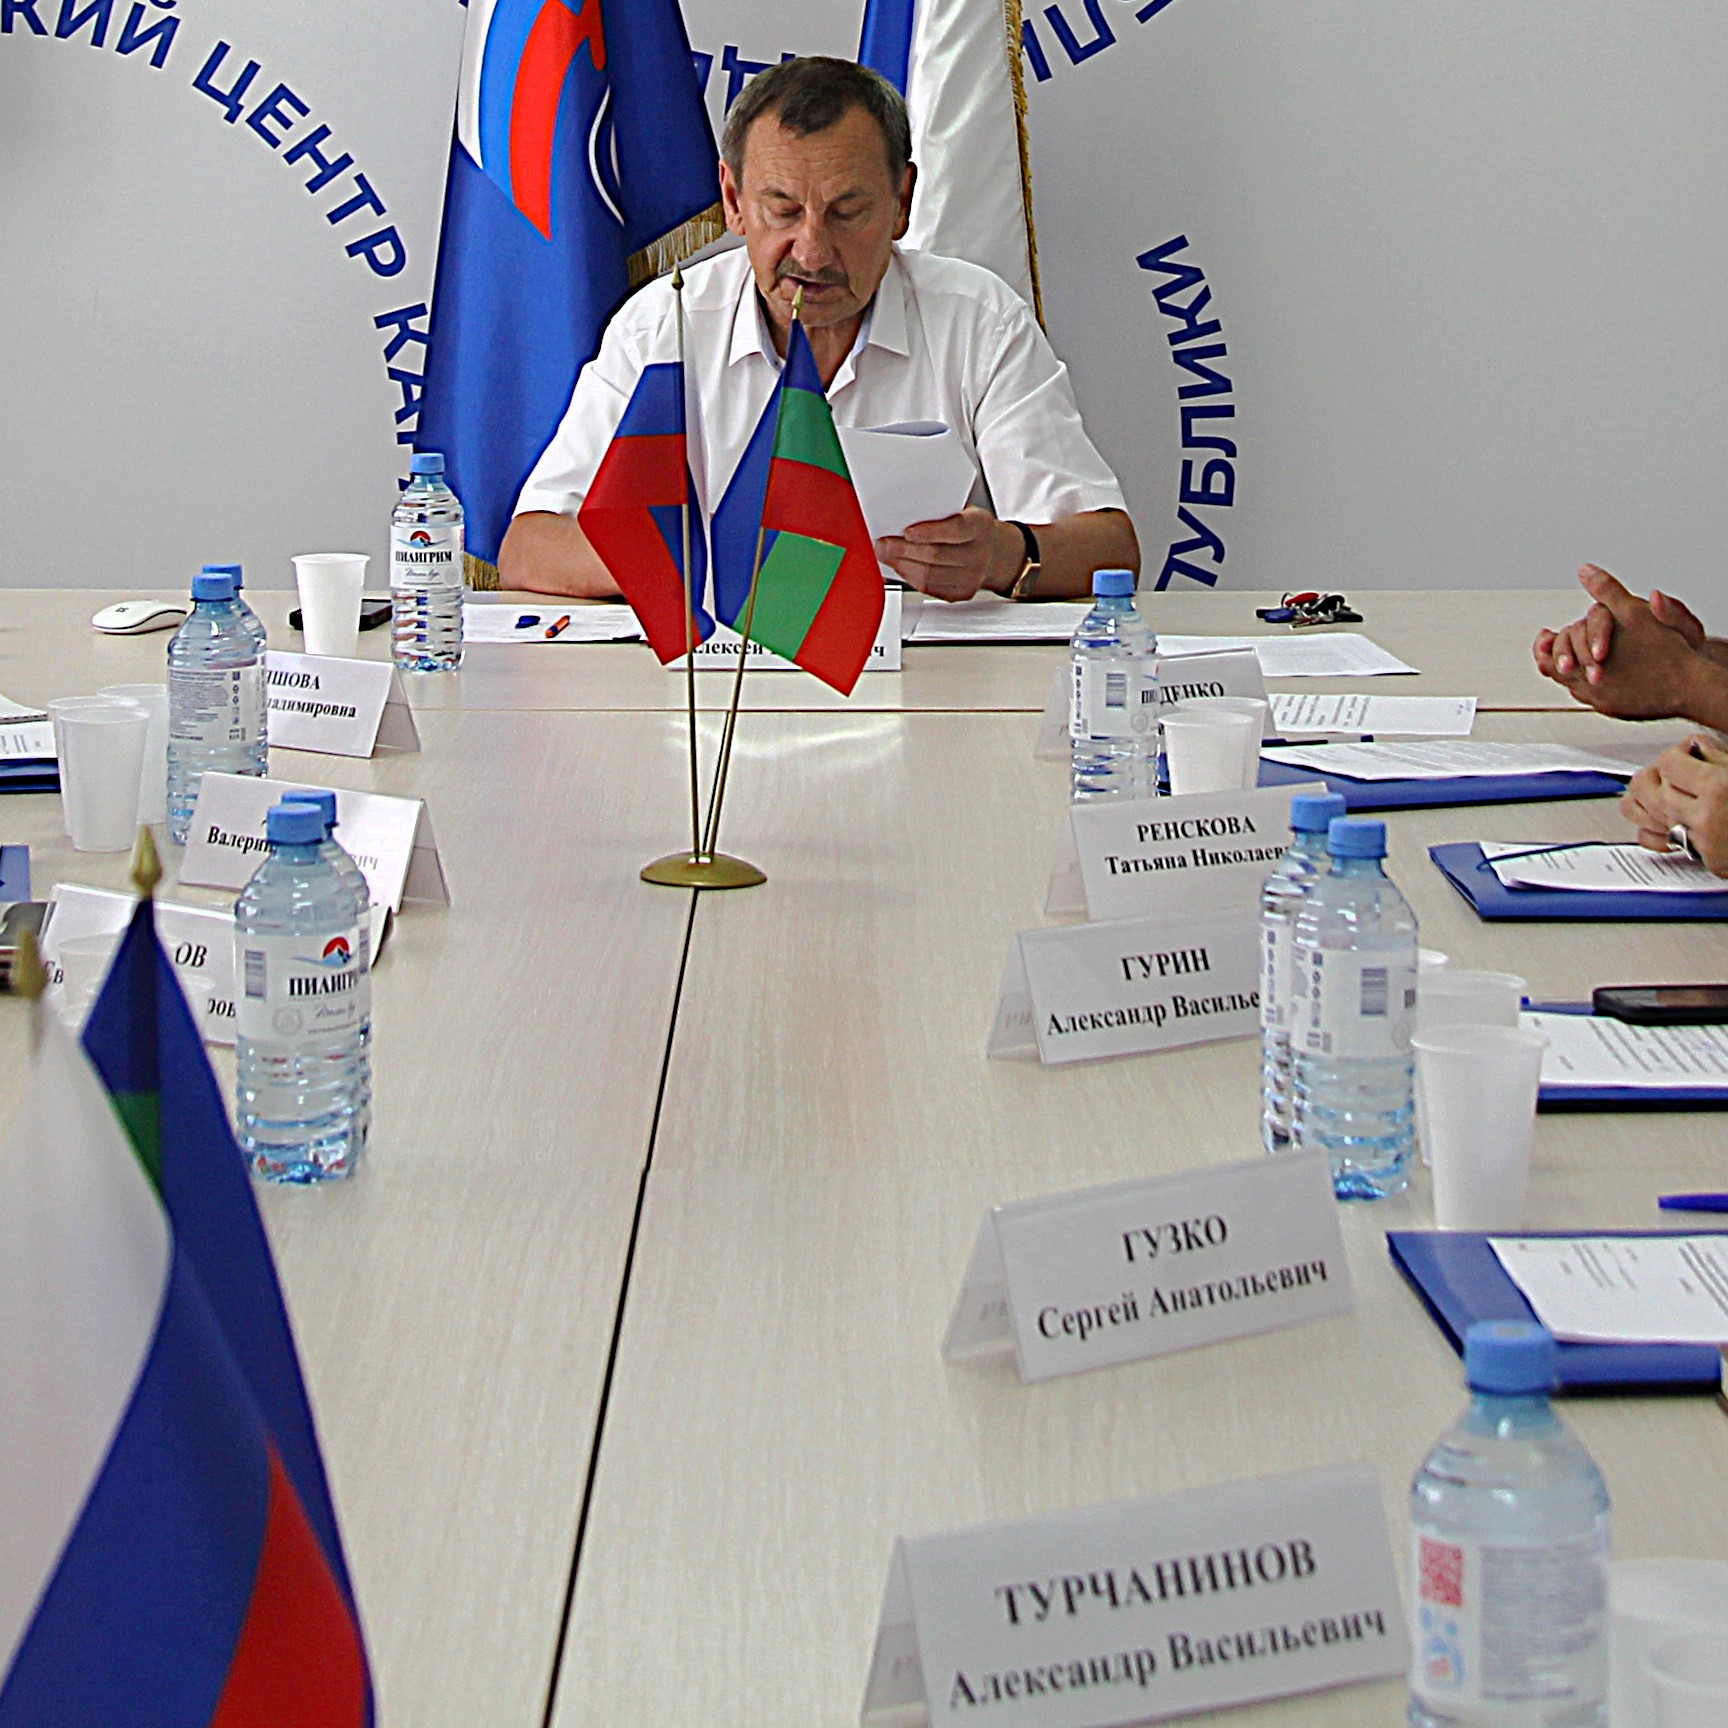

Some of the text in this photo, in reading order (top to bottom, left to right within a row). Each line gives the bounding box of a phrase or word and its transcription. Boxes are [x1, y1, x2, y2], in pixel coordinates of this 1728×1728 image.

[194, 41, 407, 278] ЦЕНТР
[395, 550, 452, 564] ПИЛИГРИМ
[1137, 816, 1256, 843] РЕНСКОВА
[1104, 855, 1188, 876] Татьяна
[1121, 947, 1211, 981] ГУРИН
[1047, 1002, 1167, 1035] Александр
[1122, 1215, 1228, 1263] ГУЗКО
[1038, 1258, 1328, 1340] Сергей Анатольевич
[994, 1539, 1318, 1626] ТУРЧАНИНОВ
[950, 1606, 1388, 1710] Александр Васильевич
